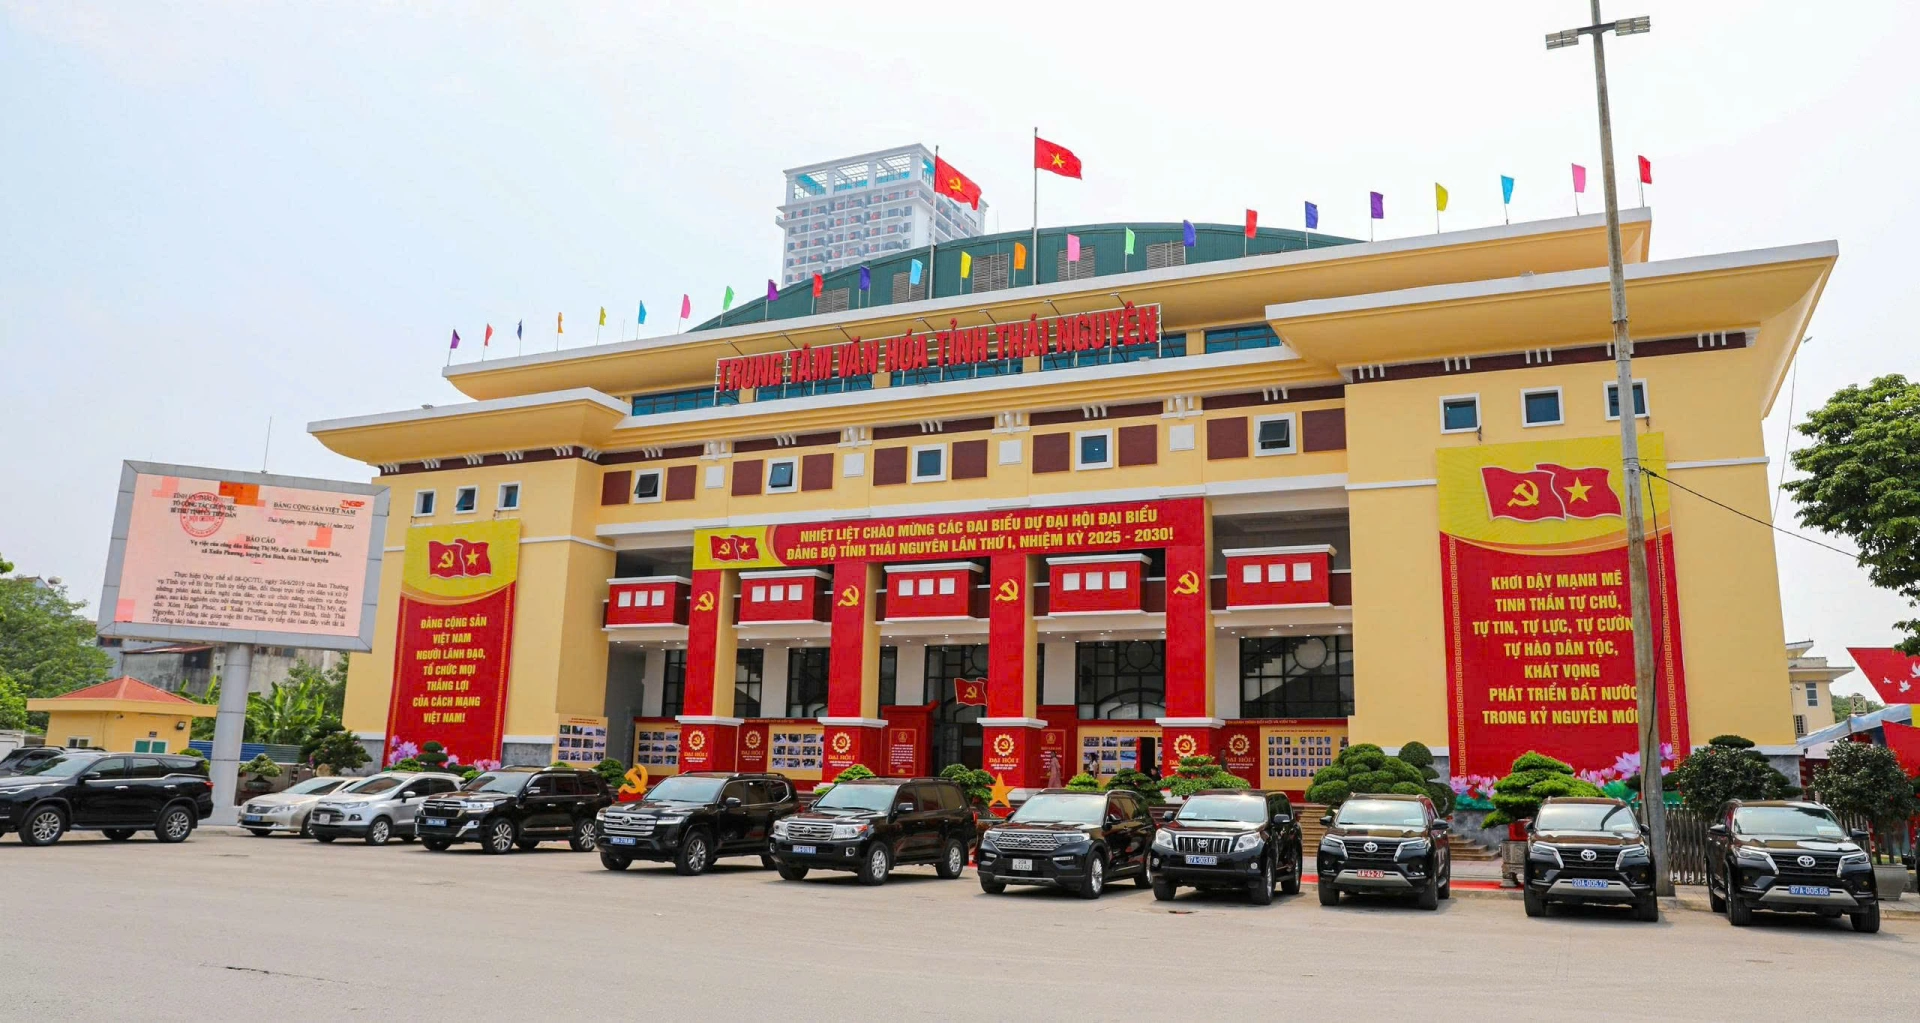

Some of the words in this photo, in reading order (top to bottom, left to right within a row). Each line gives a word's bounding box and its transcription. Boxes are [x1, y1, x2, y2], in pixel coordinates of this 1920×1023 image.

[719, 354, 784, 391] TRUNG
[789, 344, 832, 382] TÂM
[837, 336, 879, 377] VĂN
[885, 328, 928, 372] HÓA
[936, 318, 988, 366] TỈNH
[995, 314, 1049, 359] THÁI
[1056, 300, 1157, 352] NGUYÊN
[801, 528, 834, 545] NHIỆT
[837, 526, 859, 543] LIỆT
[863, 524, 894, 538] CHÀO
[898, 522, 934, 537] MỪNG
[938, 520, 963, 534] CÁC
[966, 520, 987, 534] ĐẠI
[992, 514, 1020, 531] BIỂU
[1025, 515, 1043, 531] DỰ
[1046, 515, 1068, 530] ĐẠI
[1072, 511, 1094, 528] HỘI
[1099, 512, 1121, 527] ĐẠI
[1126, 505, 1157, 523] BIỂU
[787, 545, 817, 560] ĐẢNG
[821, 544, 836, 560] BỘ
[839, 538, 866, 557] TỈNH
[870, 537, 895, 555] THÁI
[900, 539, 948, 554] NGUYÊN
[952, 533, 979, 551] LẦN
[980, 531, 1005, 550] THỨ
[1008, 537, 1015, 549] I,
[1020, 532, 1062, 549] NHIỆM
[1067, 527, 1086, 545] KỲ
[1088, 531, 1121, 544] 2025
[1135, 527, 1173, 541] 2030!
[1492, 575, 1522, 590] KHƠI
[1527, 573, 1551, 591] DẬY
[1557, 573, 1597, 589] MẠNH
[1602, 570, 1622, 585] MẼ
[1495, 598, 1525, 611] TINH
[1529, 593, 1564, 610] THẦN
[1569, 595, 1586, 612] TỰ
[1590, 591, 1621, 609] CHỦ,
[421, 616, 442, 628] ĐẢNG
[445, 616, 467, 629] CỘNG
[470, 614, 486, 626] SẢN
[1473, 621, 1489, 637] TỰ
[1492, 621, 1518, 635] TIN,
[1522, 619, 1539, 636] TỰ
[1543, 618, 1572, 635] LỰC,
[1576, 618, 1593, 634] TỰ
[1597, 615, 1634, 633] CƯỜN
[433, 632, 450, 645] VIỆT
[452, 633, 471, 643] NAM
[417, 648, 441, 659] NGƯỜI
[443, 648, 464, 659] LÃNH
[467, 649, 485, 660] ĐẠO,
[1504, 642, 1521, 659] TỰ
[1525, 640, 1551, 656] HÀO
[1556, 639, 1583, 655] DÂN
[1588, 639, 1618, 657] TỘC,
[424, 663, 433, 675] TỔ
[435, 664, 457, 675] CHỨC
[459, 665, 475, 676] MỌI
[1525, 662, 1558, 678] KHÁT
[1563, 664, 1599, 680] VỌNG
[427, 678, 453, 690] THẮNG
[456, 680, 468, 692] LỢI
[1490, 686, 1523, 701] PHÁT
[1527, 682, 1566, 701] TRIỂN
[1571, 683, 1596, 700] ĐẤT
[413, 695, 428, 706] CỦA
[431, 696, 453, 706] CÁCH
[455, 697, 480, 708] MẠNG
[424, 711, 441, 724] VIỆT
[443, 713, 465, 722] NAM!
[1482, 711, 1526, 724] TRONG
[1531, 706, 1547, 724] KỶ
[1552, 708, 1607, 724] NGUYÊN
